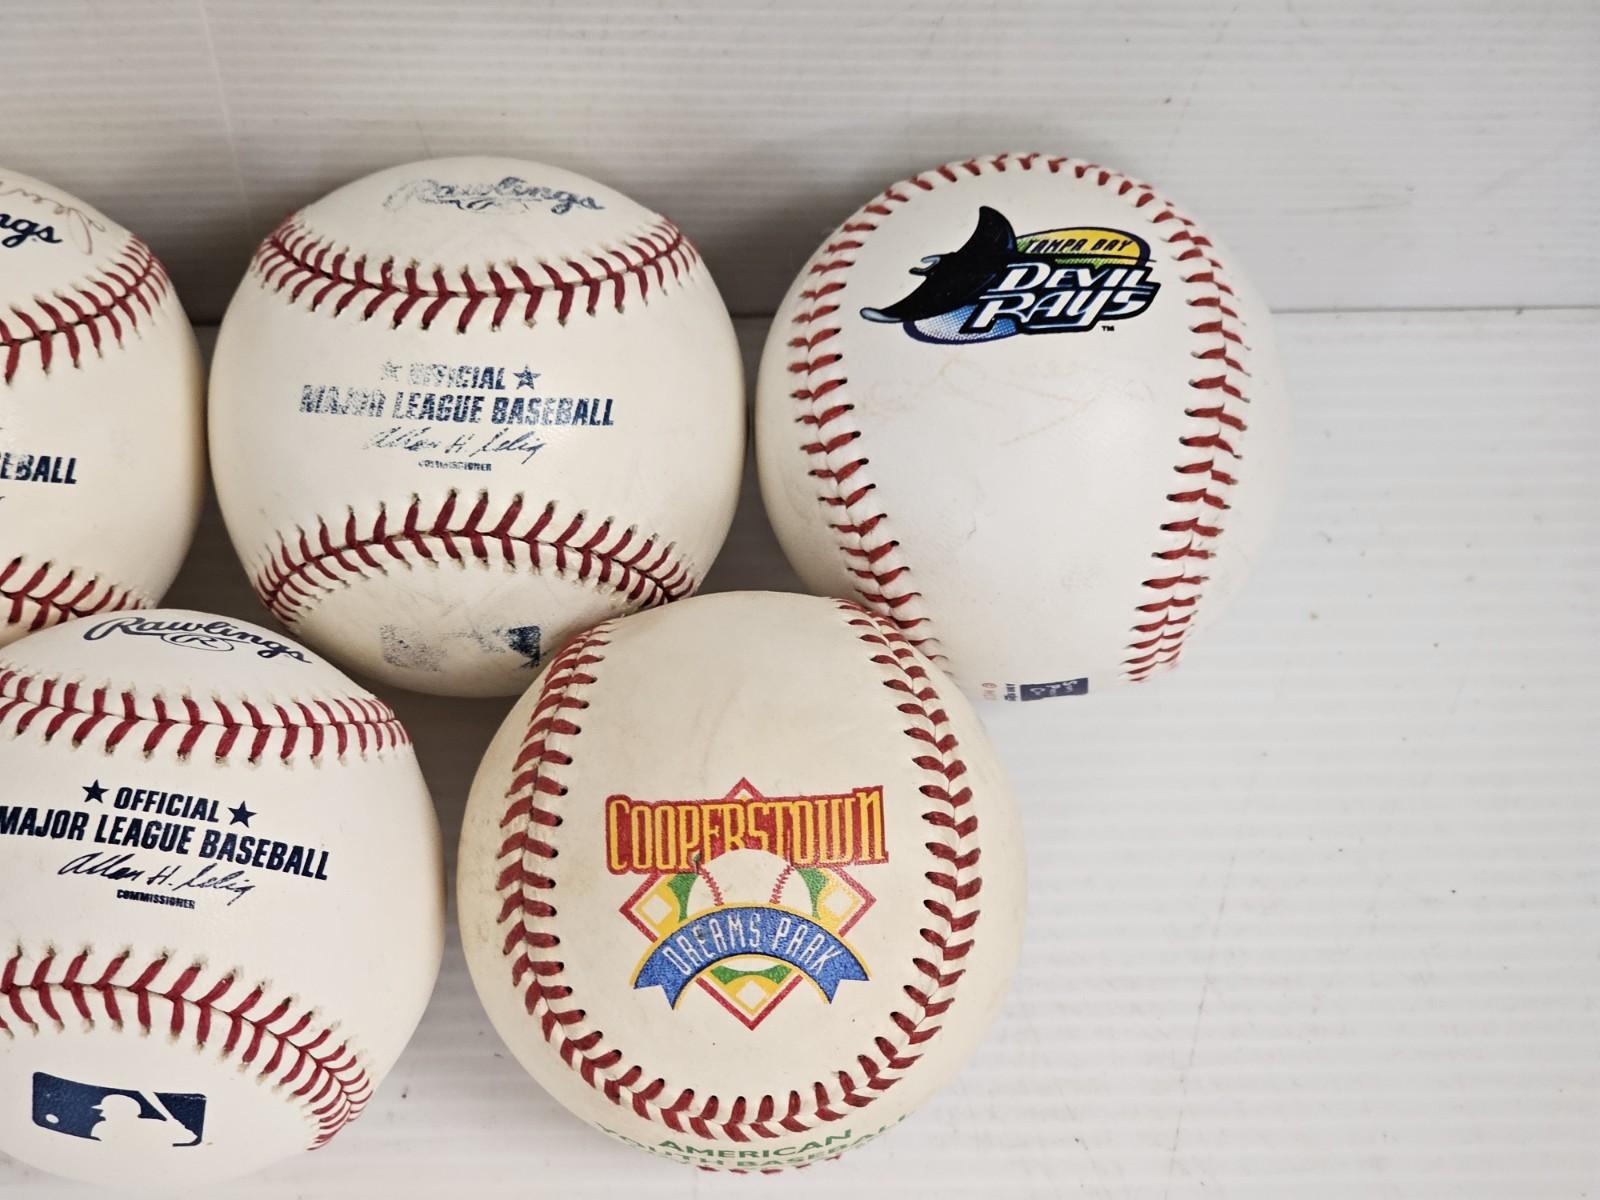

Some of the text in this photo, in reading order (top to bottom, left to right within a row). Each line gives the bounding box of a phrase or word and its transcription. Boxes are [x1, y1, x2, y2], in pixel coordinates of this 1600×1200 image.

[1028, 237, 1133, 254] TAMPA BAY
[988, 262, 1154, 291] DEVIL
[972, 289, 1151, 329] RAYS
[392, 391, 485, 423] LEAGUE
[491, 396, 614, 426] BASEBALL
[83, 617, 313, 664] Rawlings
[114, 786, 220, 822] OFFICIAL
[0, 805, 330, 880] MAJOR LEAGUE BASEBALL
[608, 789, 885, 872] COOPERSTOWN
[116, 889, 195, 910] COMMISSIONER
[662, 911, 841, 976] DREAMS PARK
[658, 1129, 851, 1158] AMERICAN
